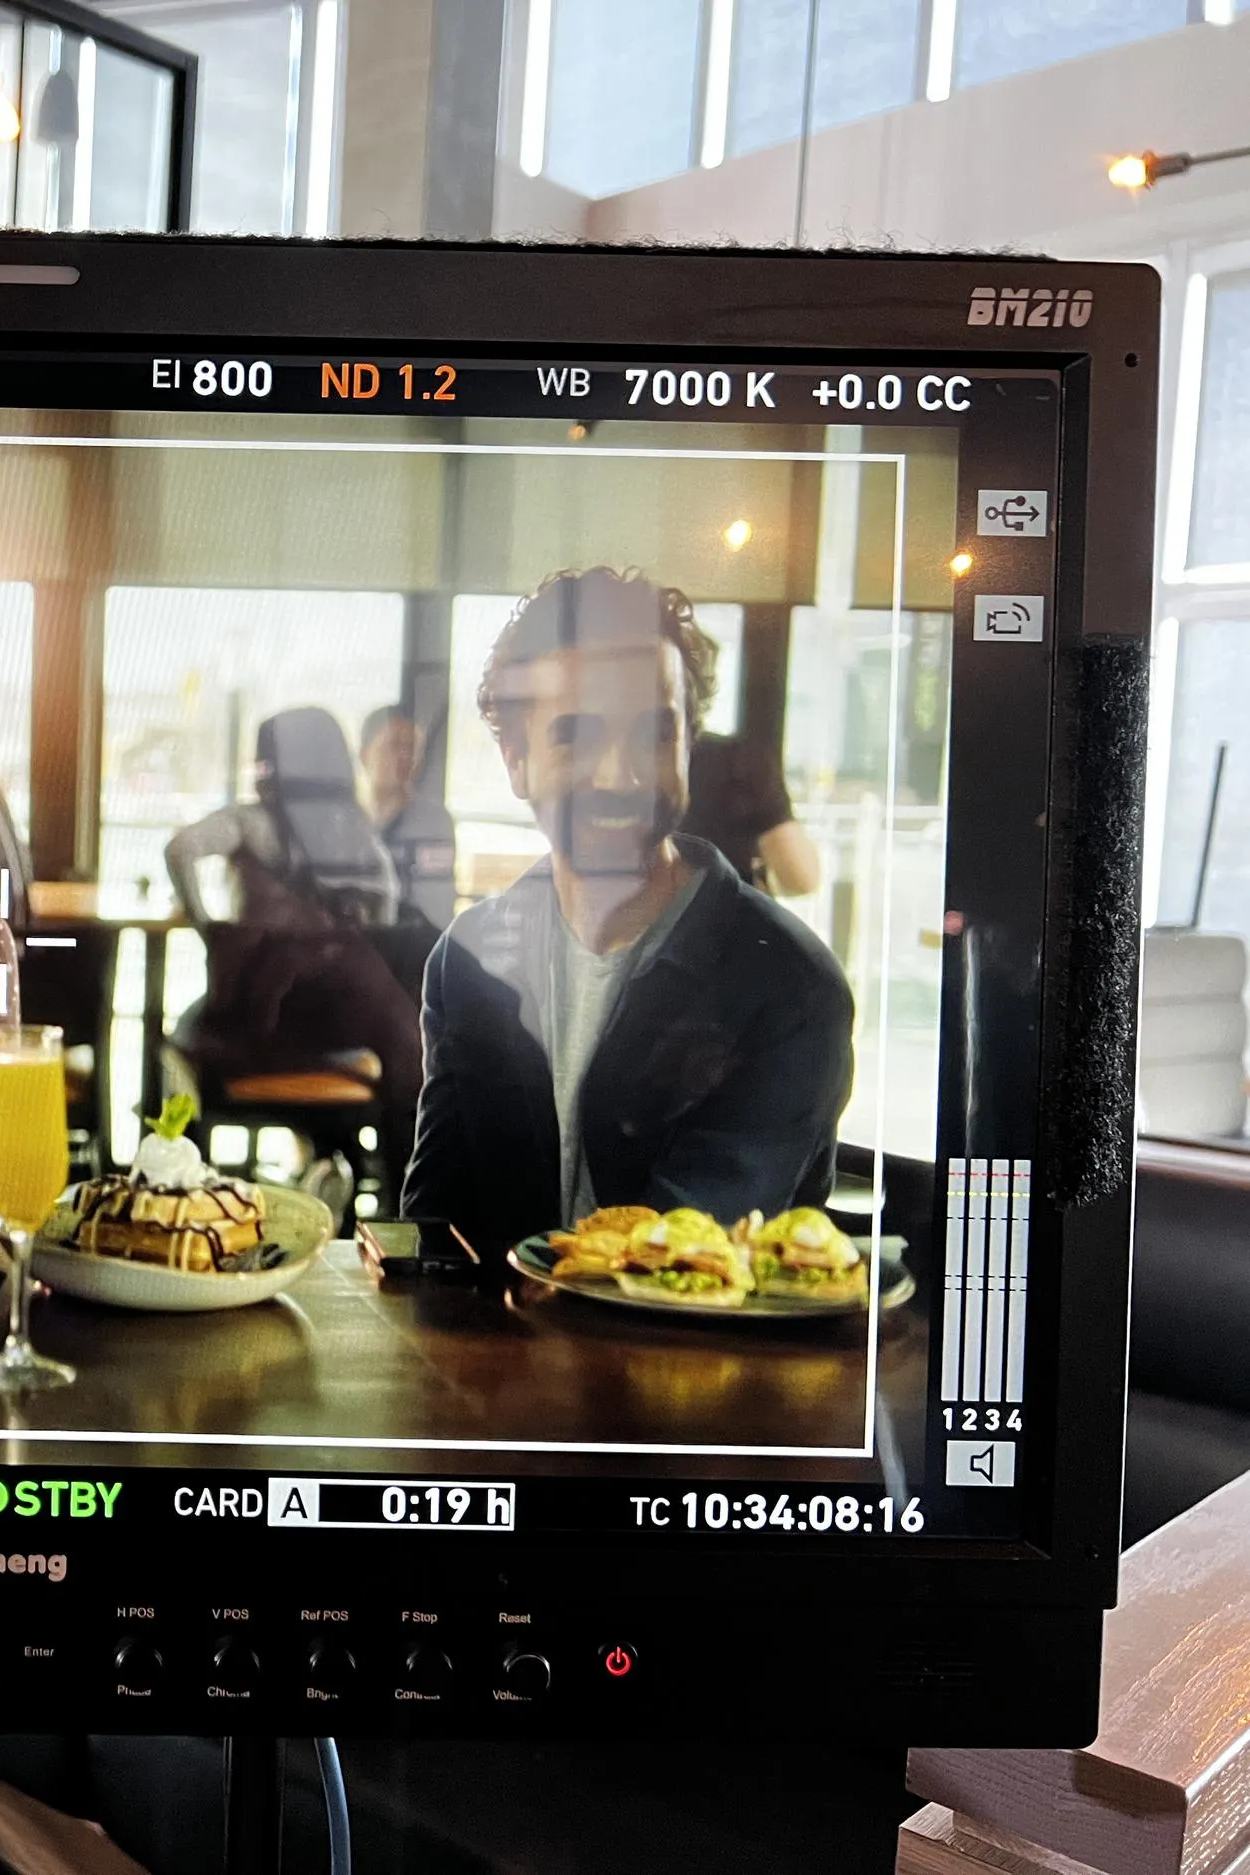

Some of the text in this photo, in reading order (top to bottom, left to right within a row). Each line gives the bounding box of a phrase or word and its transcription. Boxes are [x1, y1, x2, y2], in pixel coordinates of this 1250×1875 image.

[967, 287, 1093, 328] BM210
[152, 358, 273, 398] EI 800
[321, 362, 457, 401] ND 1.2
[536, 367, 776, 408] WB 7000 K
[812, 373, 972, 412] +0.0 CC
[942, 1407, 1023, 1432] 1 2 3 4
[13, 1480, 123, 1519] STBY
[174, 1486, 510, 1525] CARD A 0:19 h
[629, 1492, 925, 1533] TC 10:34:08:16
[117, 1607, 155, 1618] H POS
[212, 1608, 249, 1620] V POS
[300, 1609, 349, 1621] Ref POS
[401, 1611, 438, 1625] F Stop
[498, 1612, 531, 1624] Reset
[24, 1646, 55, 1657] Enter
